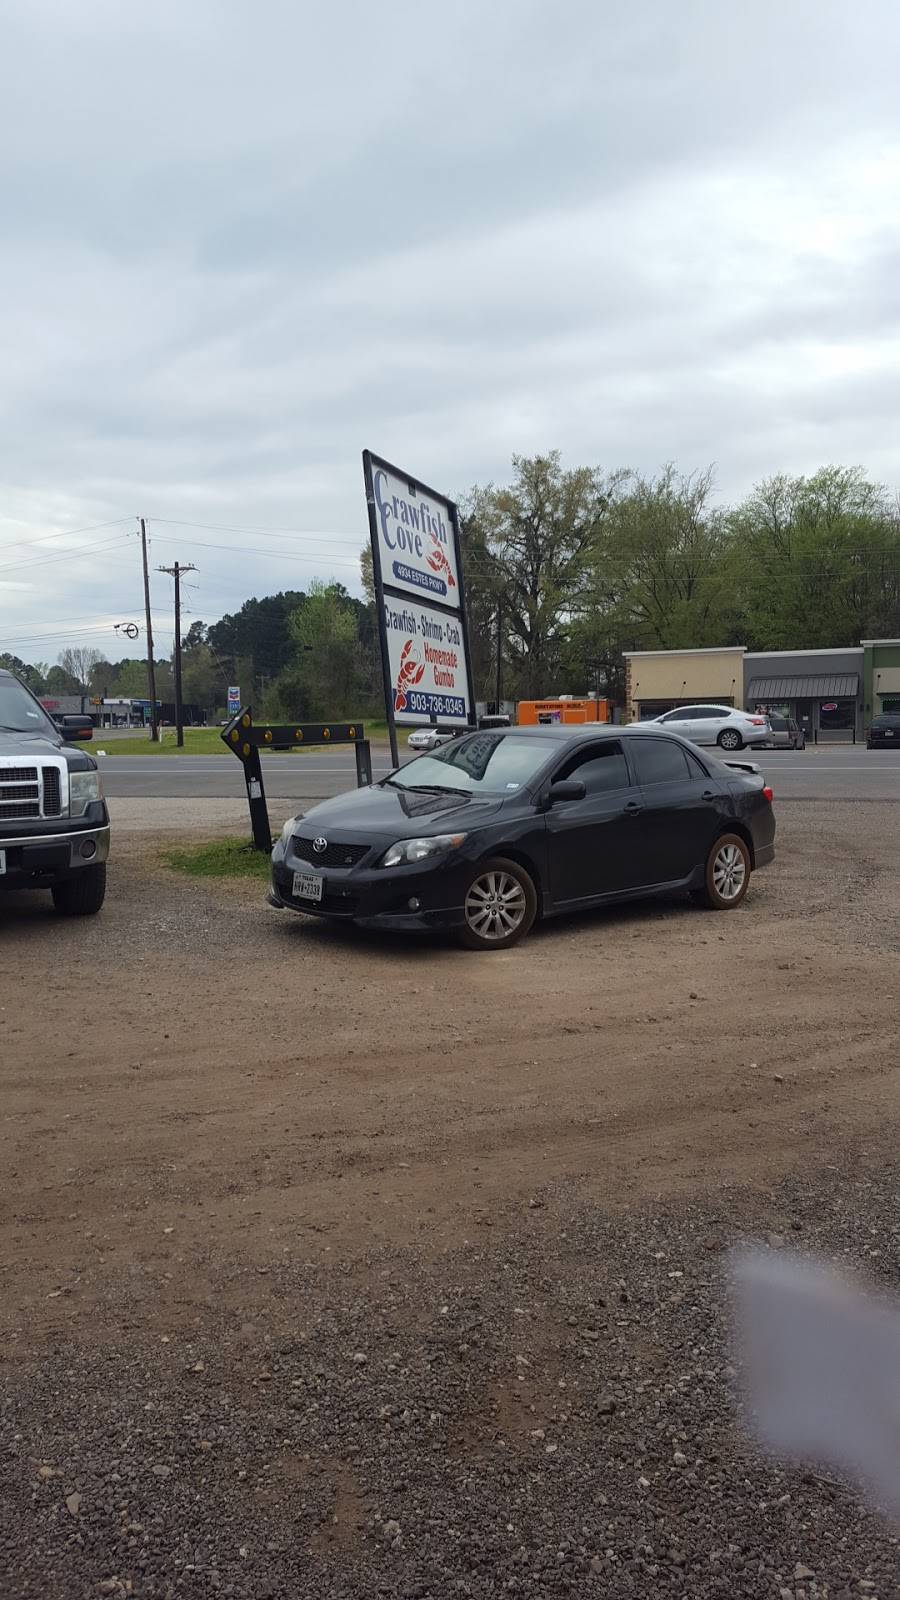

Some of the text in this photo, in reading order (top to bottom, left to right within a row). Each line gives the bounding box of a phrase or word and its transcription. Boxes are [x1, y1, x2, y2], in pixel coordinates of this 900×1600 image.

[374, 469, 447, 544] Crawfish
[380, 502, 423, 558] Cove
[398, 565, 443, 592] 4934 ESTES PKWY
[384, 604, 417, 635] Crawfish
[421, 614, 443, 642] Shrimp
[446, 622, 460, 646] Crab
[423, 640, 457, 669] Homemade
[434, 664, 455, 688] Gumbo
[410, 693, 463, 714] 903-736-0345
